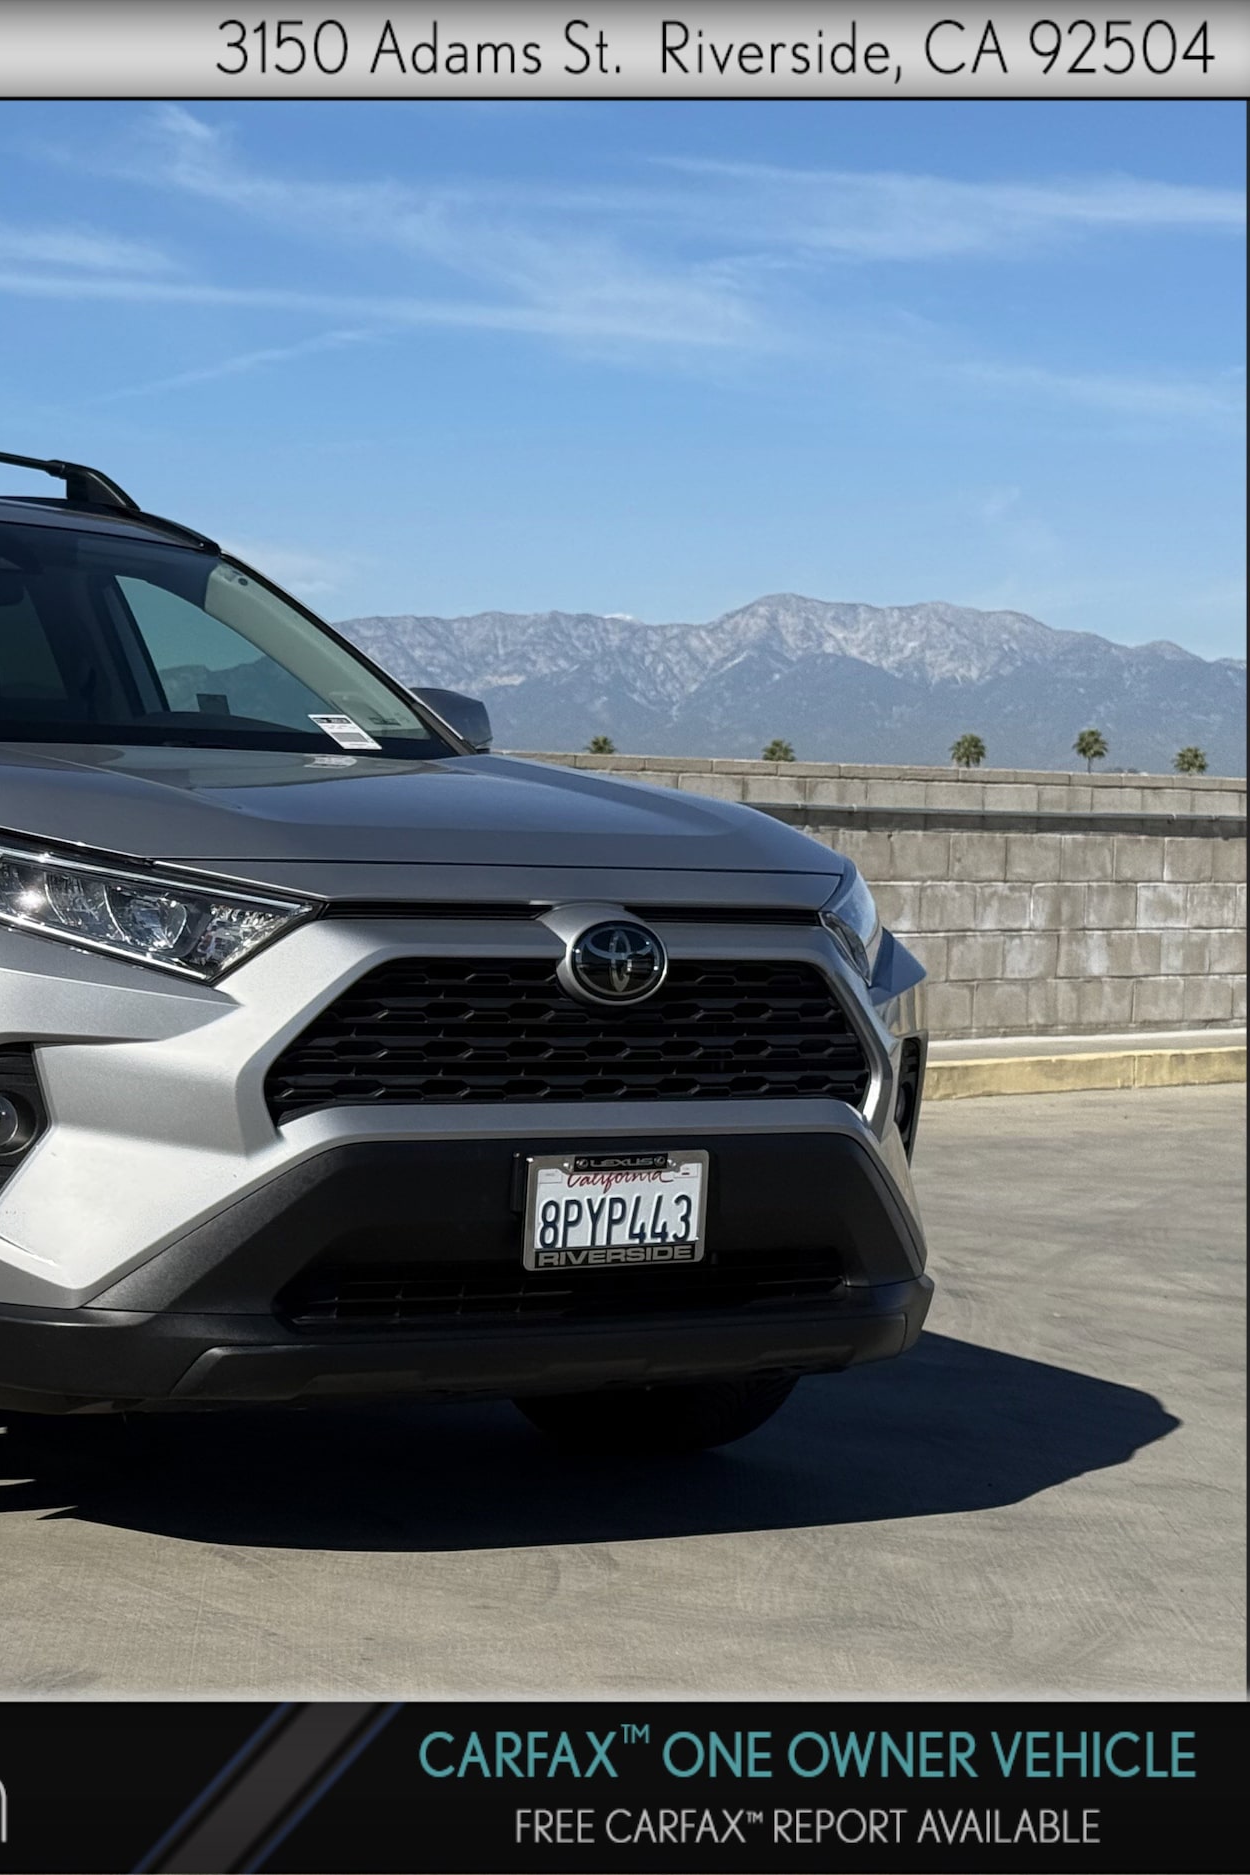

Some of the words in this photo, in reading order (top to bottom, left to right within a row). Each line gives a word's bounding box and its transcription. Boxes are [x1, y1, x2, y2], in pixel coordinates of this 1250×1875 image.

[589, 1156, 654, 1168] LEXUS
[539, 1194, 693, 1249] 8PYP443
[538, 1245, 693, 1267] RIVERSIDE
